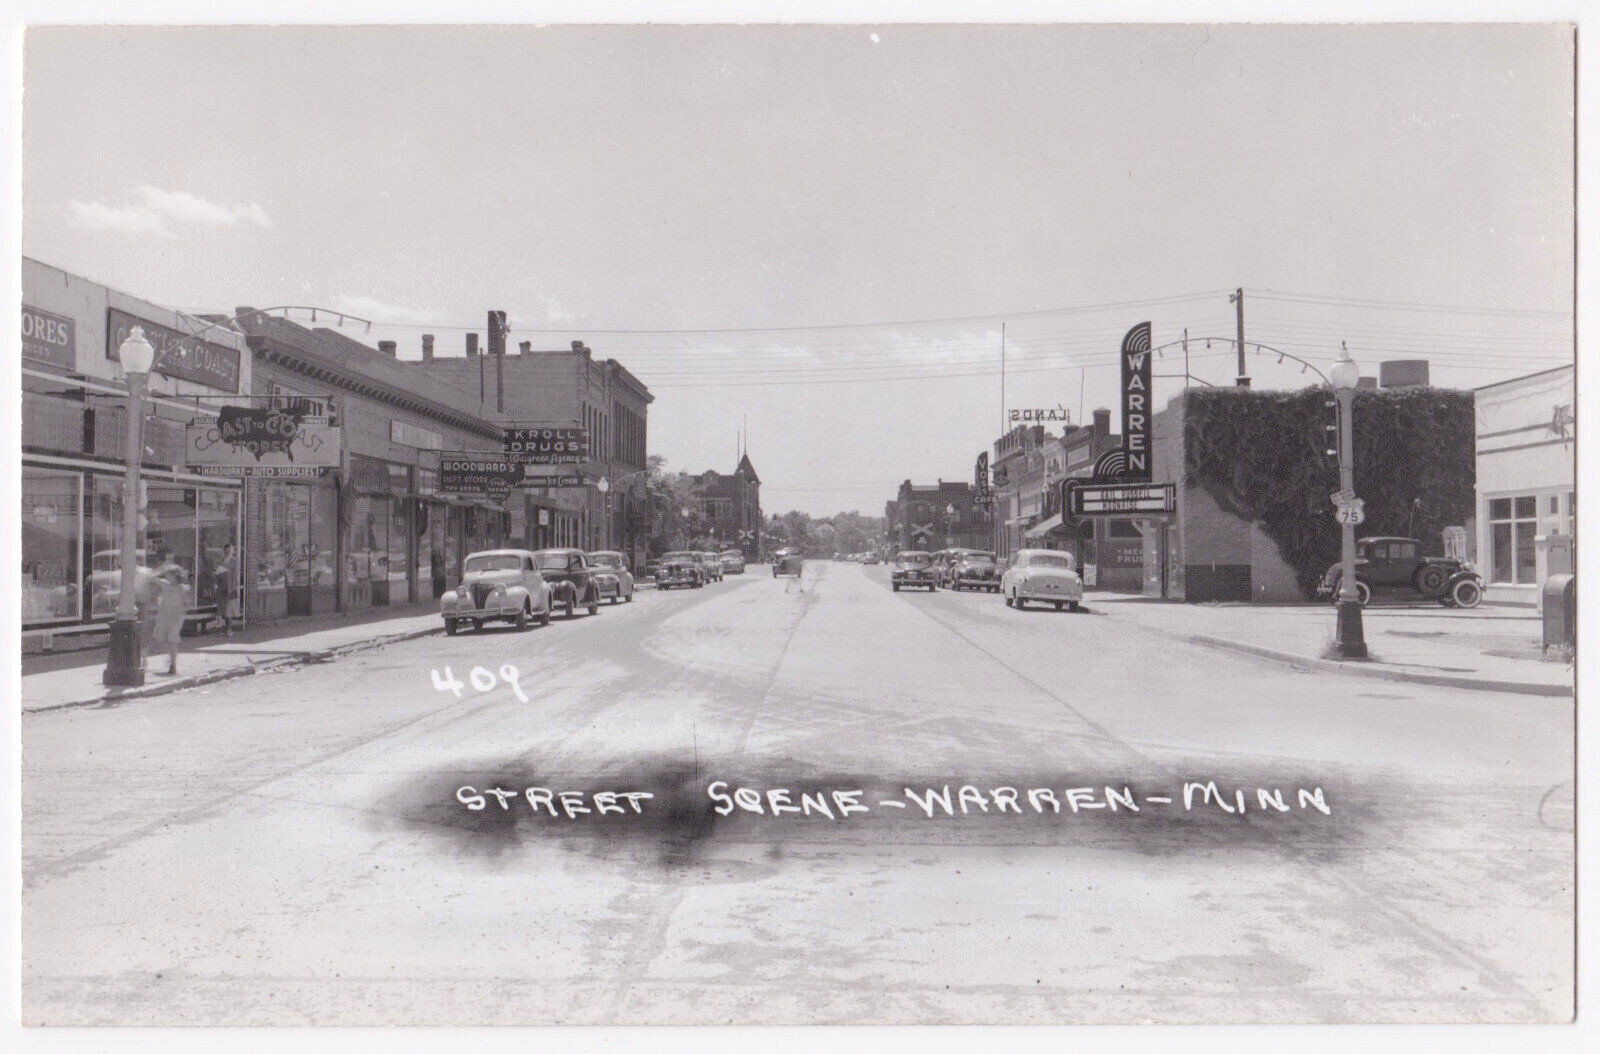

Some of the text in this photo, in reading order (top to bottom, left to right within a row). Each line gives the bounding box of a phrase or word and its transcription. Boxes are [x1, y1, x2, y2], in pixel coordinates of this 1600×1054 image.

[21, 312, 68, 347] ORES
[1127, 354, 1145, 470] WARREN
[195, 416, 253, 451] COAST
[514, 430, 576, 440] KROLL
[511, 441, 579, 452] DRUGS
[204, 467, 245, 476] HARDWARE
[252, 467, 275, 476] AUTO
[278, 467, 315, 476] SUPPLIES
[443, 461, 516, 474] WOODWARD'S
[974, 495, 999, 504] CAFE
[1342, 512, 1359, 522] 75
